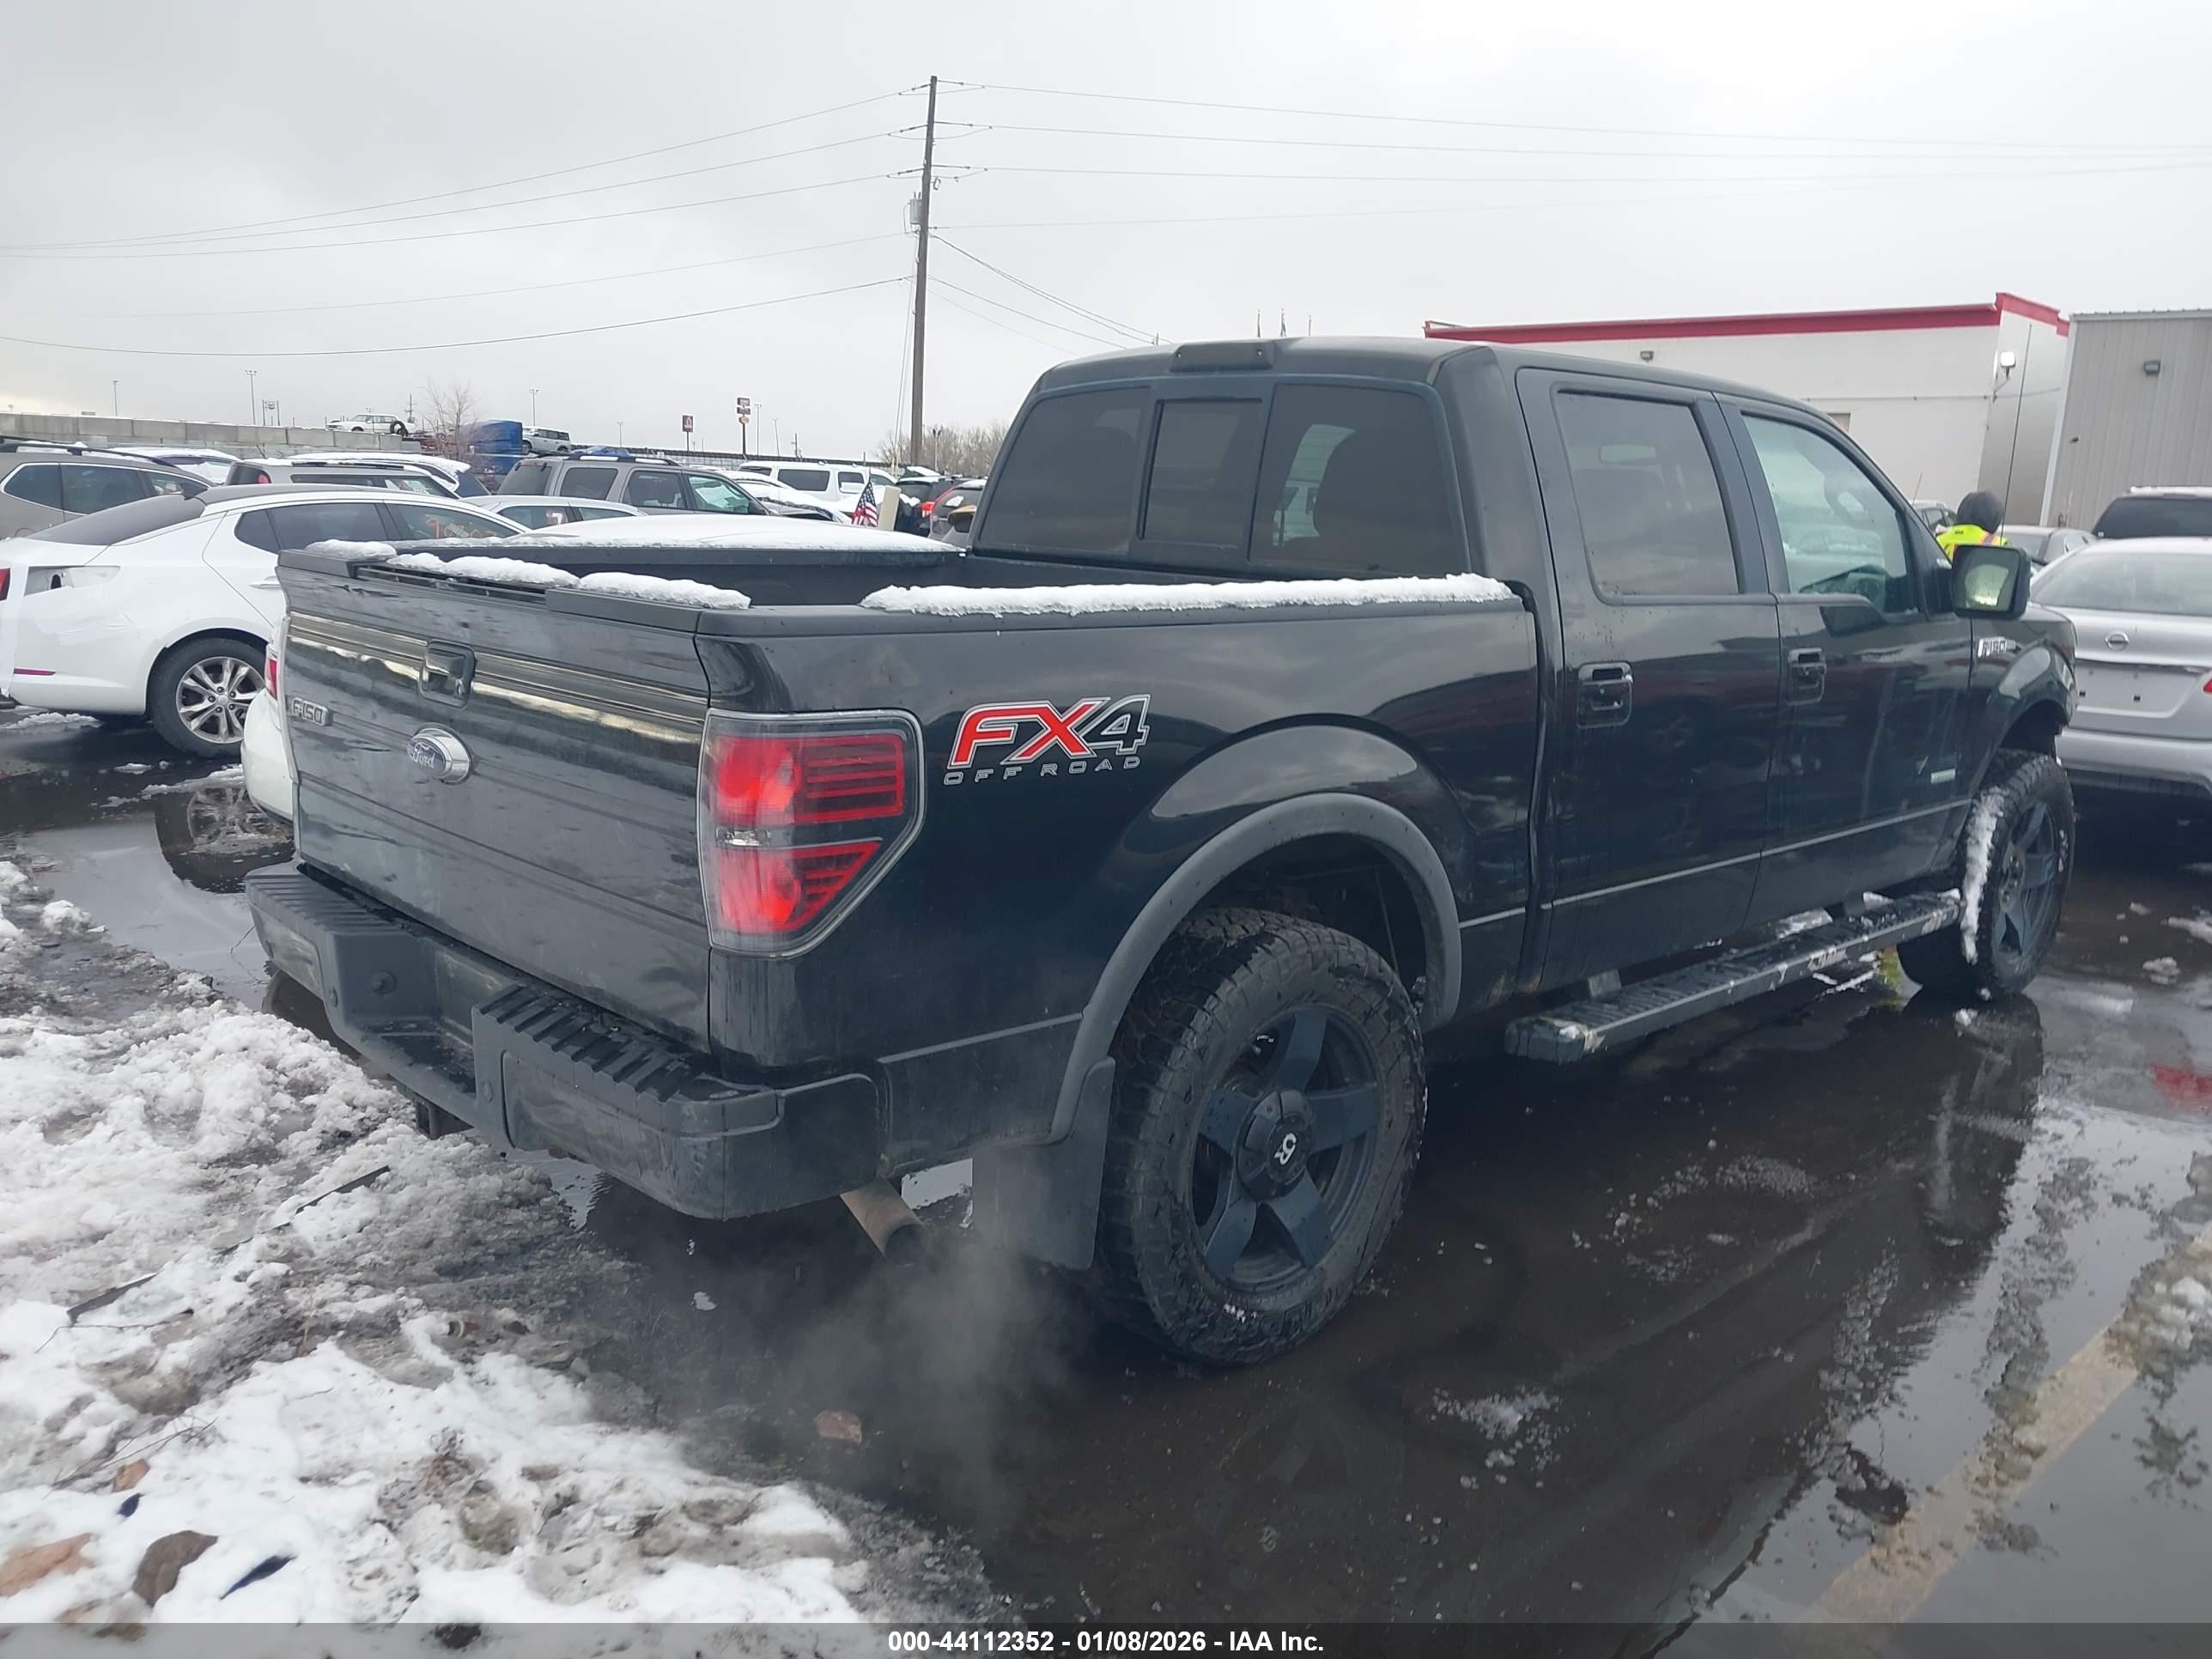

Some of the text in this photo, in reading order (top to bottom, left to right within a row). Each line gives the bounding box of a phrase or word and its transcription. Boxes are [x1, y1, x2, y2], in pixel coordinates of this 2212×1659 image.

[947, 694, 1151, 769] FX4
[412, 742, 438, 769] Ford
[944, 756, 1140, 785] OFF ROAD
